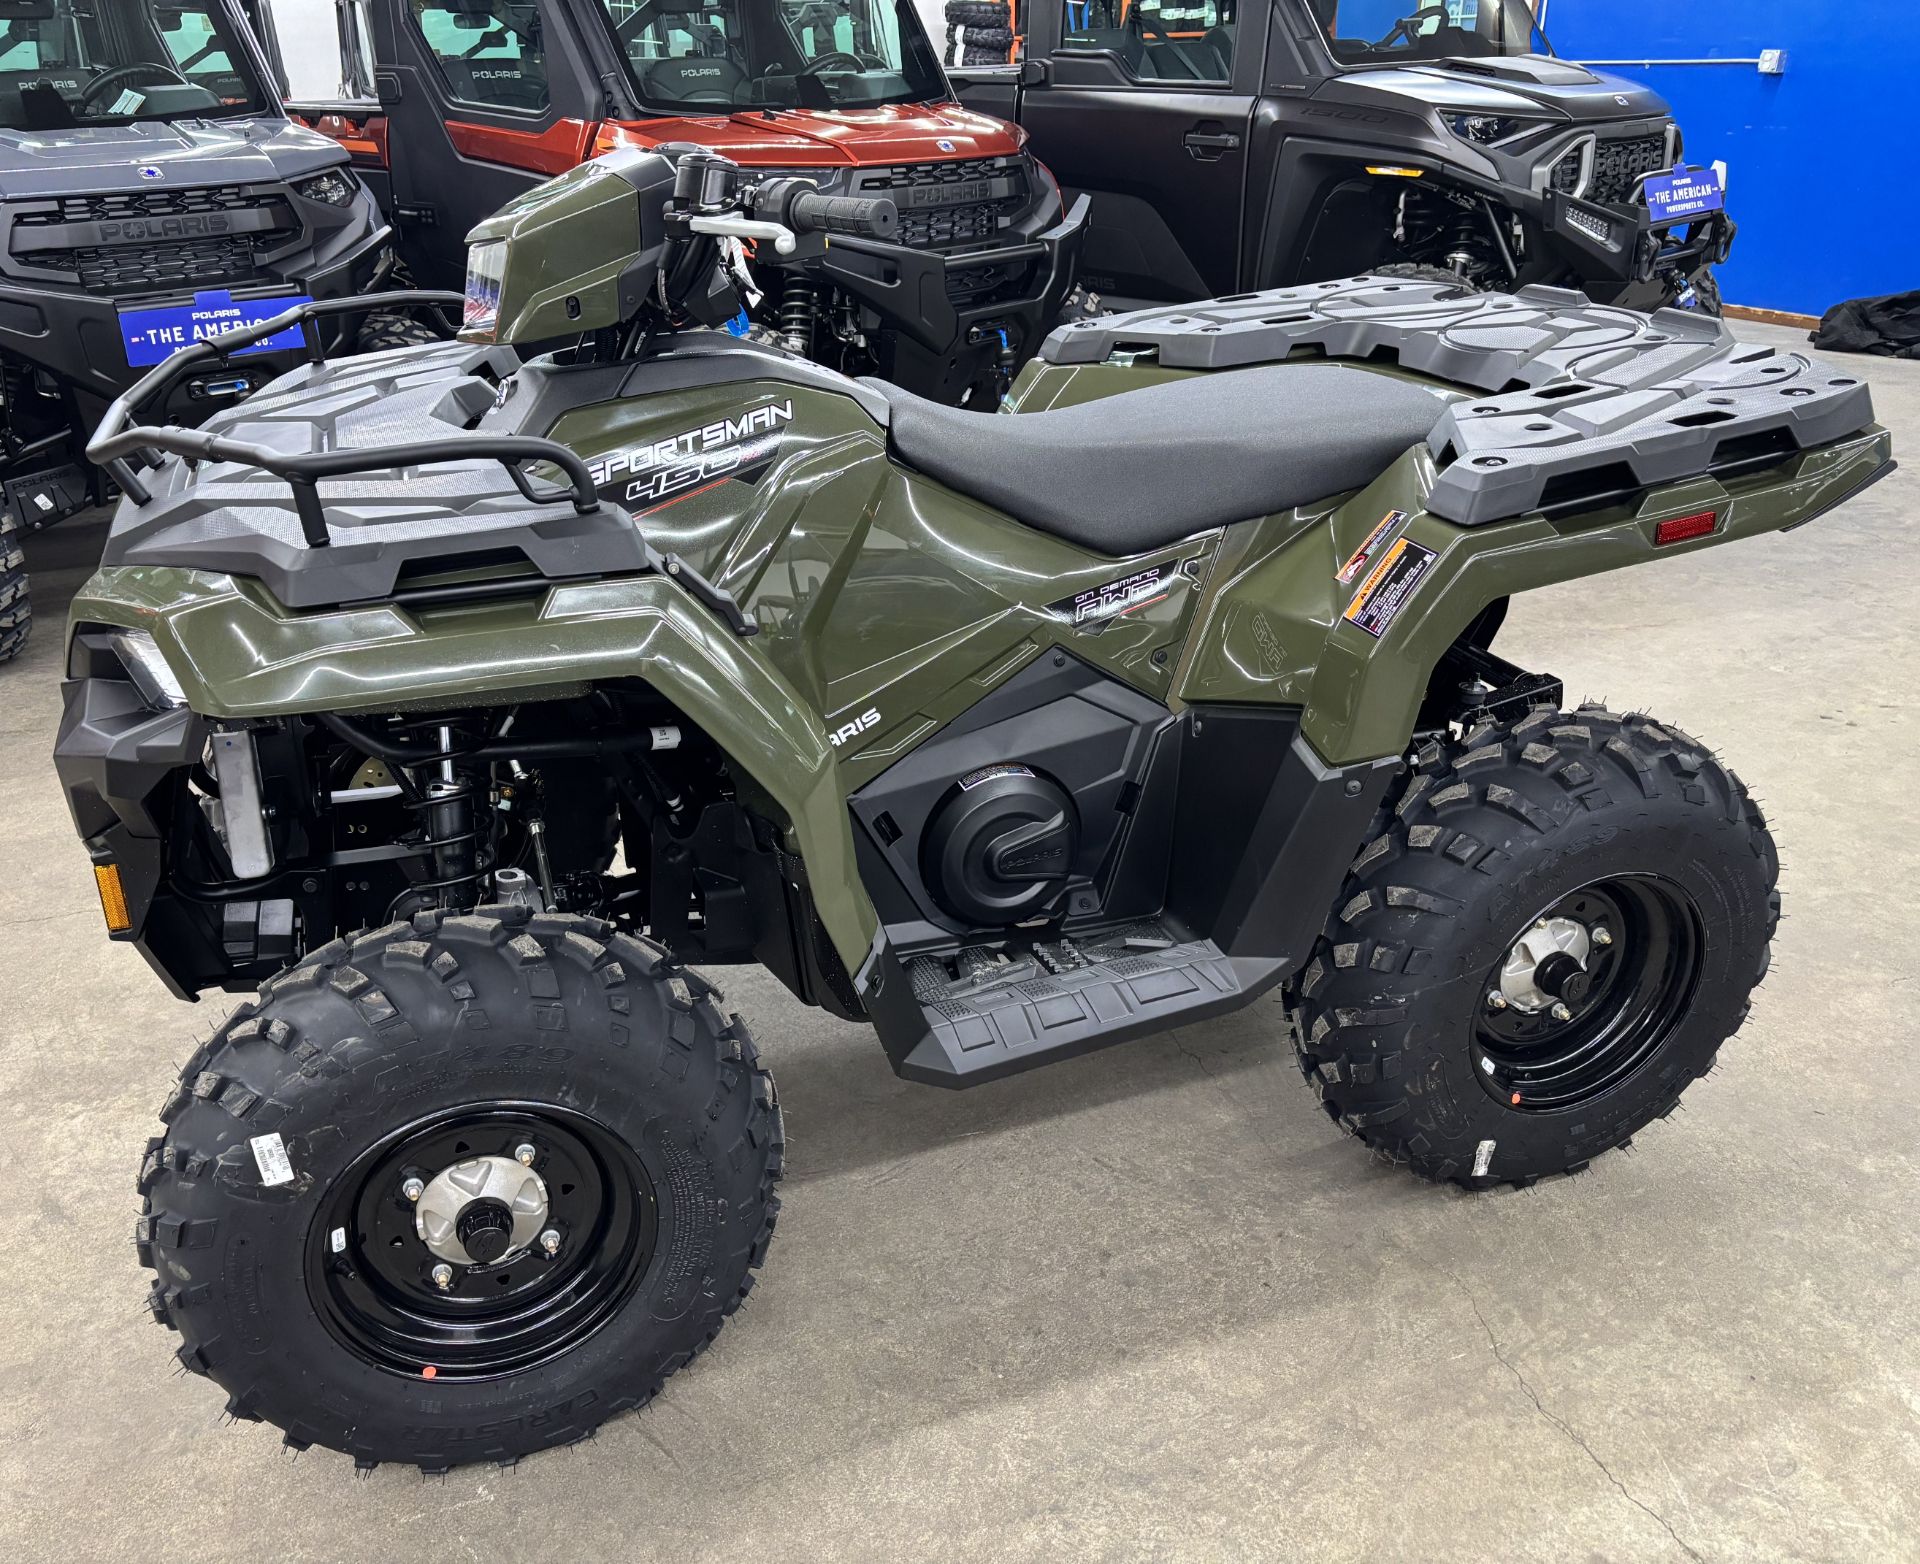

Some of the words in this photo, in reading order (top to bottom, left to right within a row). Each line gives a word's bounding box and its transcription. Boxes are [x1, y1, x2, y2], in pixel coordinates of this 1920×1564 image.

[18, 80, 78, 90] PORIS
[472, 70, 521, 79] POLARIS
[681, 68, 721, 78] POLARIS
[1593, 150, 1662, 178] POLARIS
[913, 183, 990, 204] POLARIS
[1655, 190, 1671, 204] THE
[1673, 184, 1712, 201] AMERICAN
[99, 215, 230, 241] POLARIS
[192, 308, 241, 320] POLARIS
[147, 326, 185, 345] THE
[587, 399, 793, 487] SPORTSMAN
[626, 445, 742, 500] 450
[1075, 591, 1094, 603] ON
[1100, 568, 1160, 593] DEMAND
[1365, 557, 1392, 591] WARNING
[1075, 577, 1160, 622] AWD
[828, 706, 881, 747] ARIS
